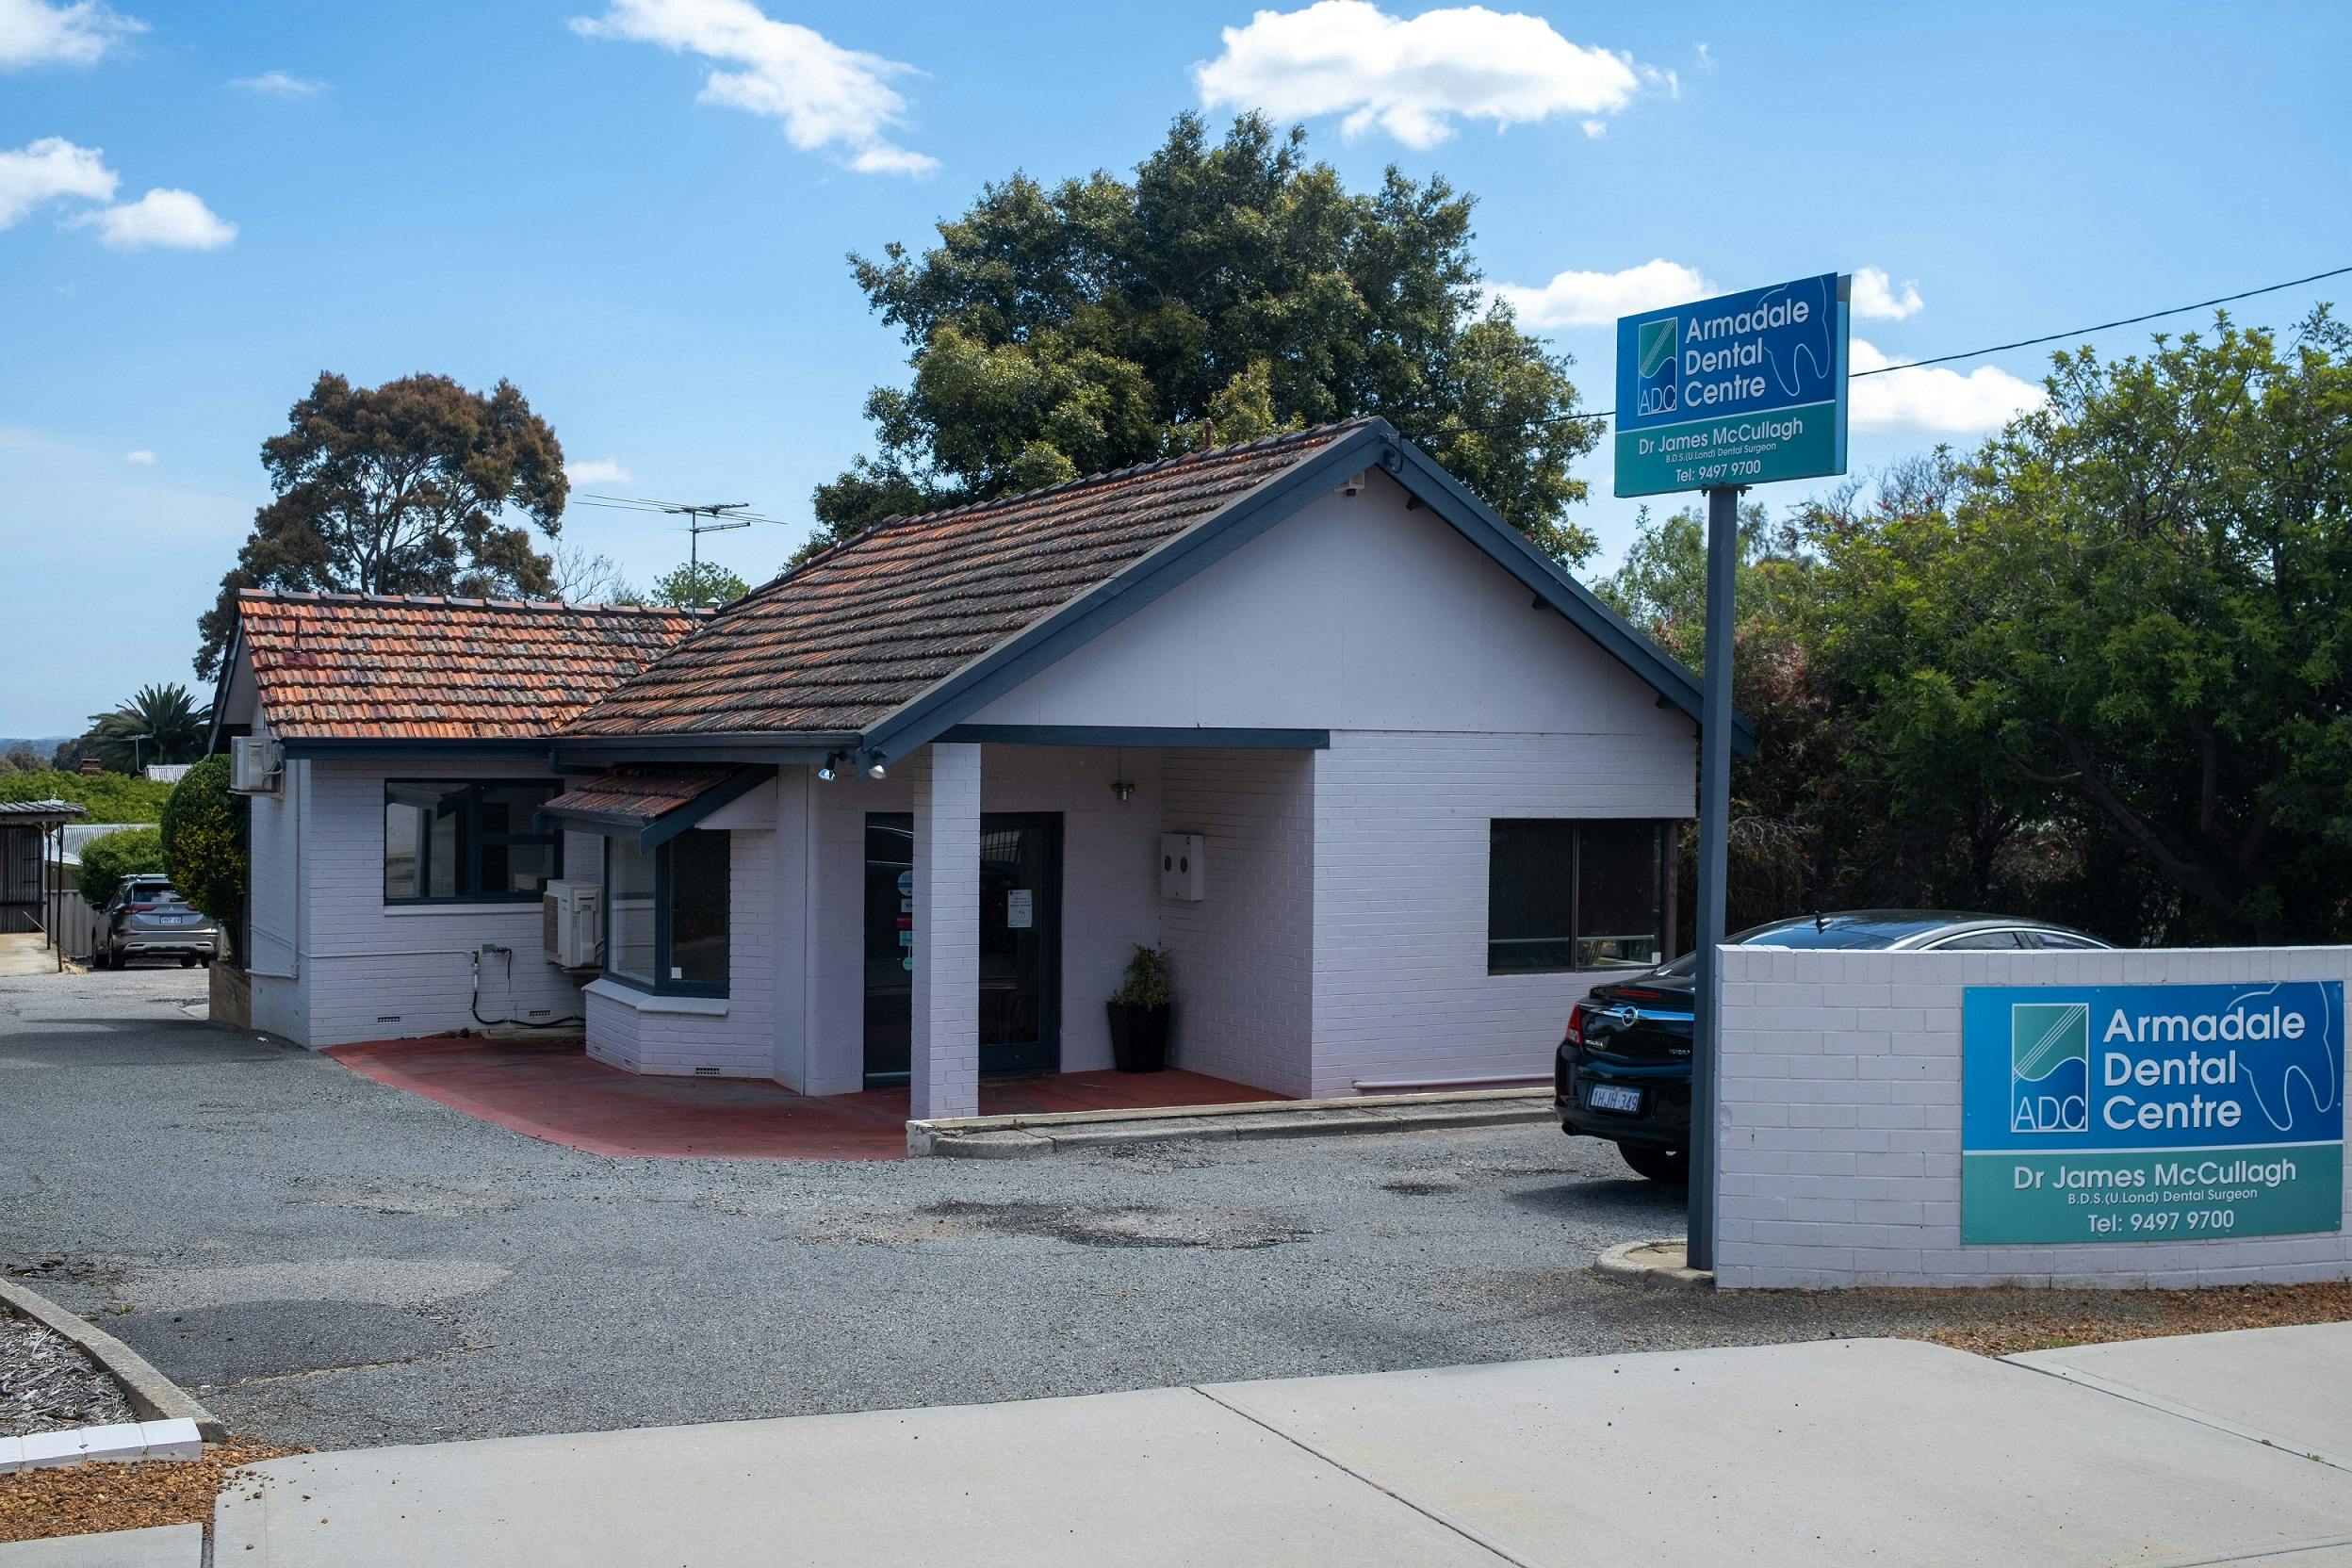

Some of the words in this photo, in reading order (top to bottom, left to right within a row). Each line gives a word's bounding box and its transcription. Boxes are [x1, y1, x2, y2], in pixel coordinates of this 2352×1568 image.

[1685, 299, 1808, 343] Armadale
[1686, 338, 1762, 376] Dental
[1640, 385, 1675, 413] ADC
[1685, 374, 1765, 407] Centre
[1640, 437, 1654, 455] Dr
[1658, 433, 1707, 451] James
[1713, 417, 1803, 443] McCullagh
[1718, 447, 1741, 456] Dental
[1744, 443, 1776, 454] Surgeon
[1676, 469, 1694, 482] Tel:
[1699, 464, 1727, 480] 9497
[1731, 460, 1760, 476] 9700
[2103, 1005, 2305, 1043] Armadale
[2104, 1050, 2235, 1086] Dental
[2014, 1095, 2084, 1130] ADC
[2103, 1094, 2241, 1130] Centre
[2015, 1167, 2044, 1189] Dr
[2052, 1165, 2144, 1189] James
[2155, 1159, 2295, 1187] McCullagh
[2164, 1190, 2204, 1201] Dental
[2208, 1188, 2257, 1203] Surgeon
[2088, 1216, 2122, 1233] Tel:
[2131, 1213, 2179, 1232] 9497
[2188, 1210, 2234, 1229] 9700
